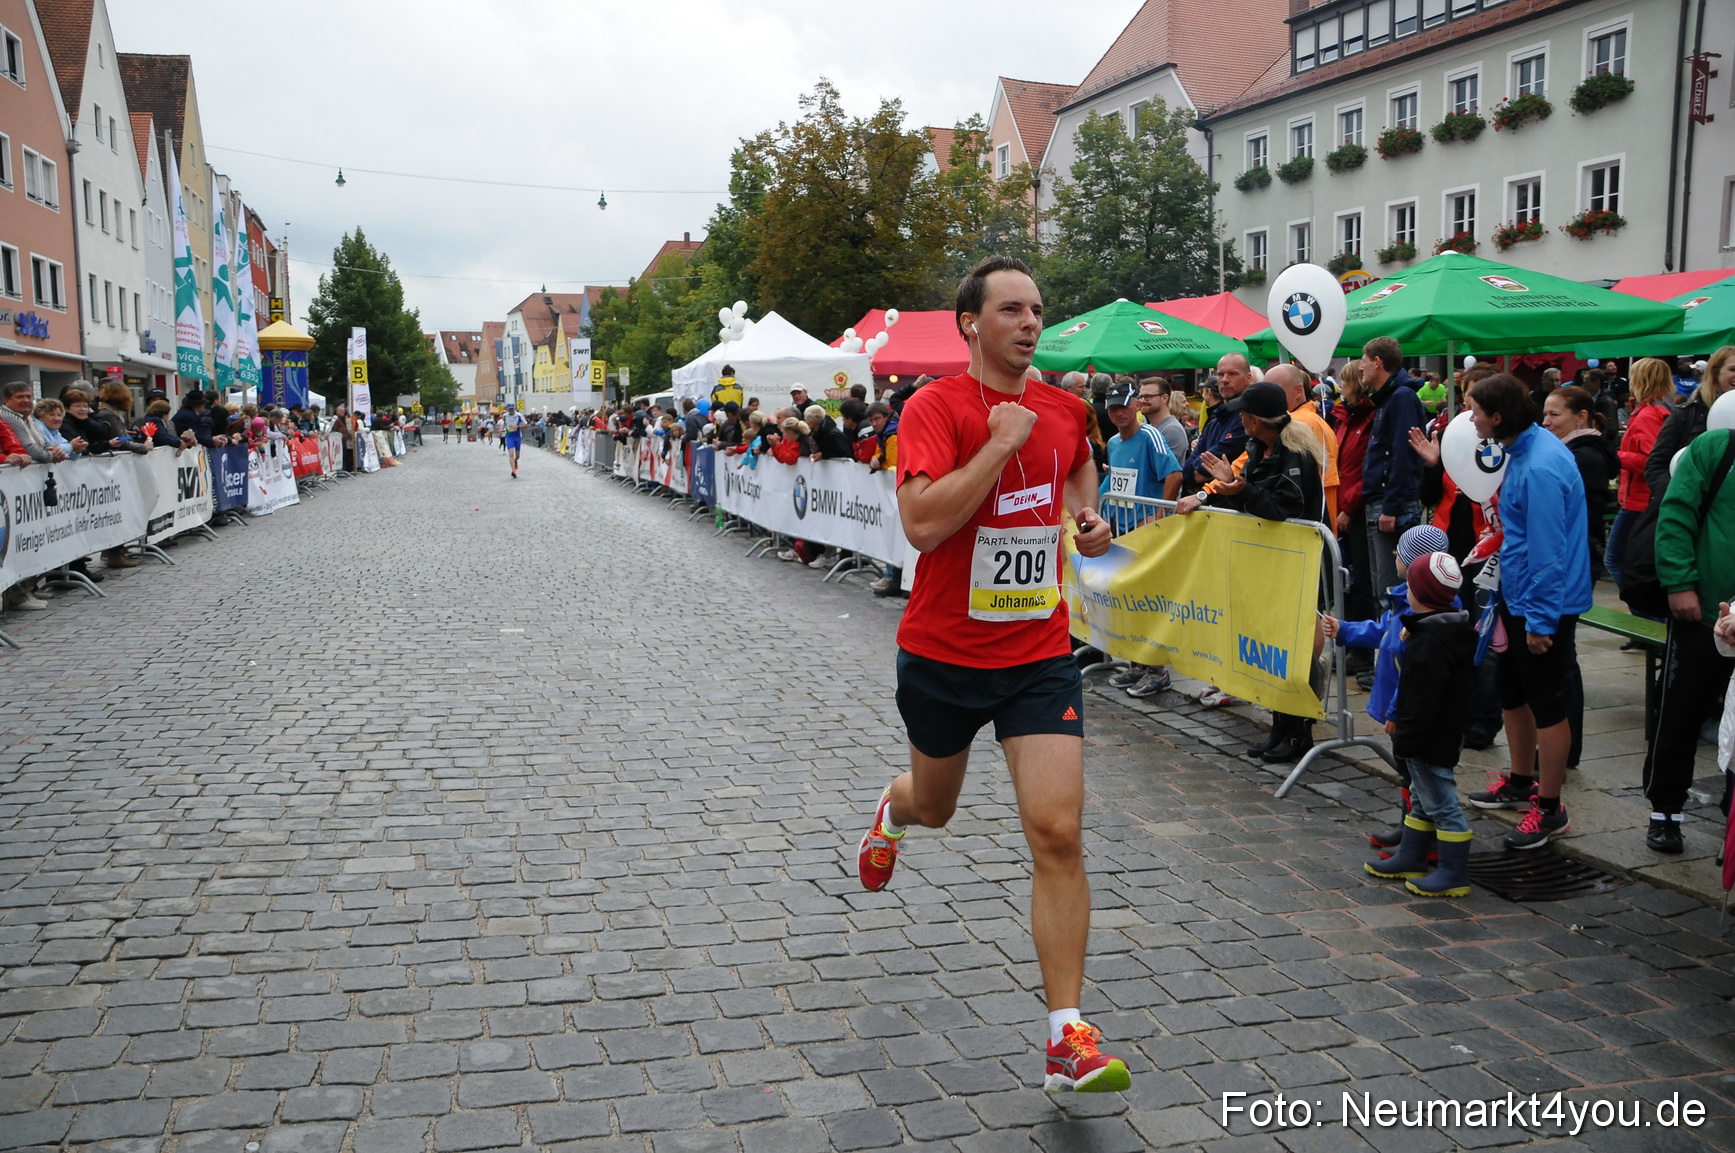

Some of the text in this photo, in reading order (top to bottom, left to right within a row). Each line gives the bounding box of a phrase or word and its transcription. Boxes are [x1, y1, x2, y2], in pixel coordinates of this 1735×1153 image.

[1694, 68, 1706, 116] Achatz
[1283, 293, 1316, 312] BMW
[1134, 343, 1211, 351] Lammsbräu
[354, 367, 363, 379] B
[593, 367, 601, 379] B
[755, 383, 791, 392] brauchen
[1112, 477, 1129, 492] 297
[1013, 493, 1038, 506] DEHN
[15, 491, 43, 525] BMW
[811, 488, 882, 530] BMW Laufsport
[15, 530, 45, 553] Weniger
[978, 536, 1050, 546] PARTL Neumarkt
[993, 549, 1046, 585] 209
[990, 595, 1046, 608] Johannes
[1238, 633, 1288, 680] KANN
